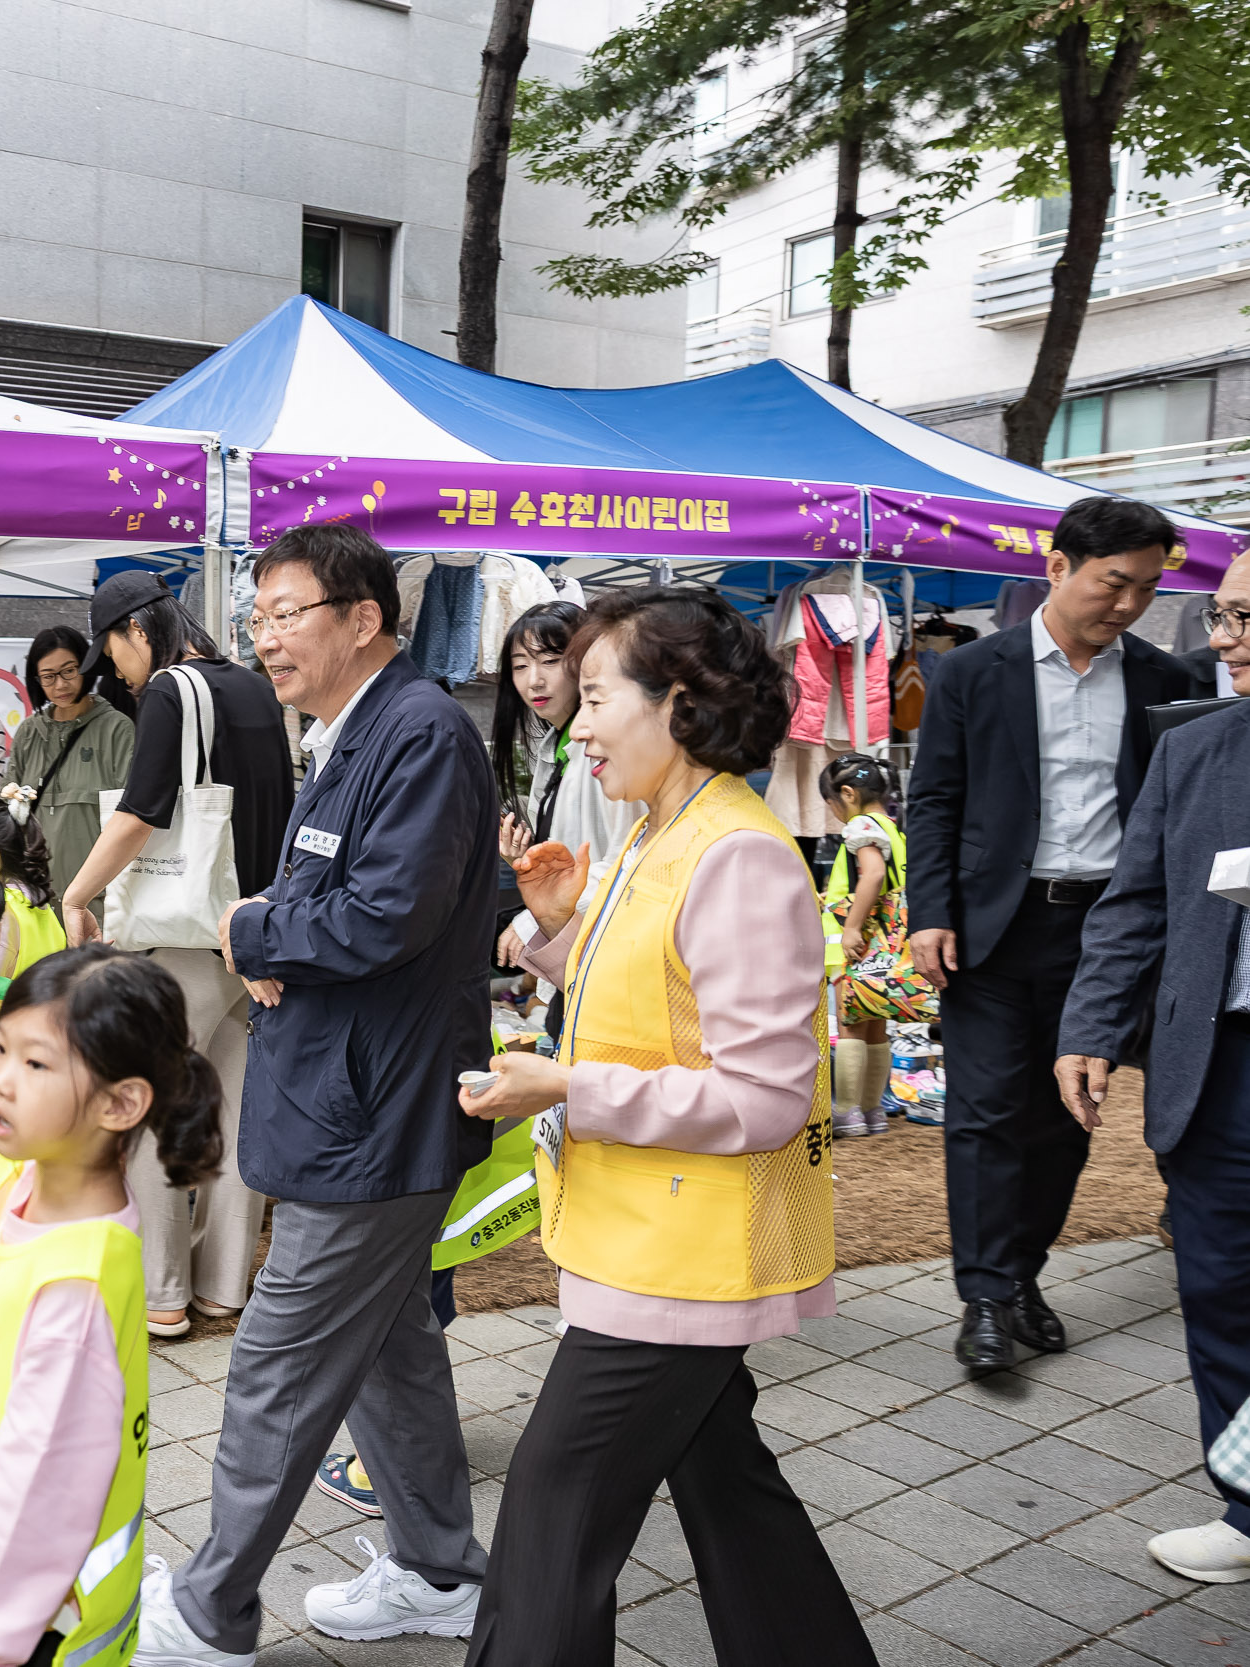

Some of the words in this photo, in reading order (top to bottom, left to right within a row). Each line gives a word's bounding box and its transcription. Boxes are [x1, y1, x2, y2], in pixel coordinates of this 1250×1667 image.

[437, 488, 498, 526] 구립
[509, 490, 731, 533] 수호천사어린이집
[988, 524, 1033, 555] 구립
